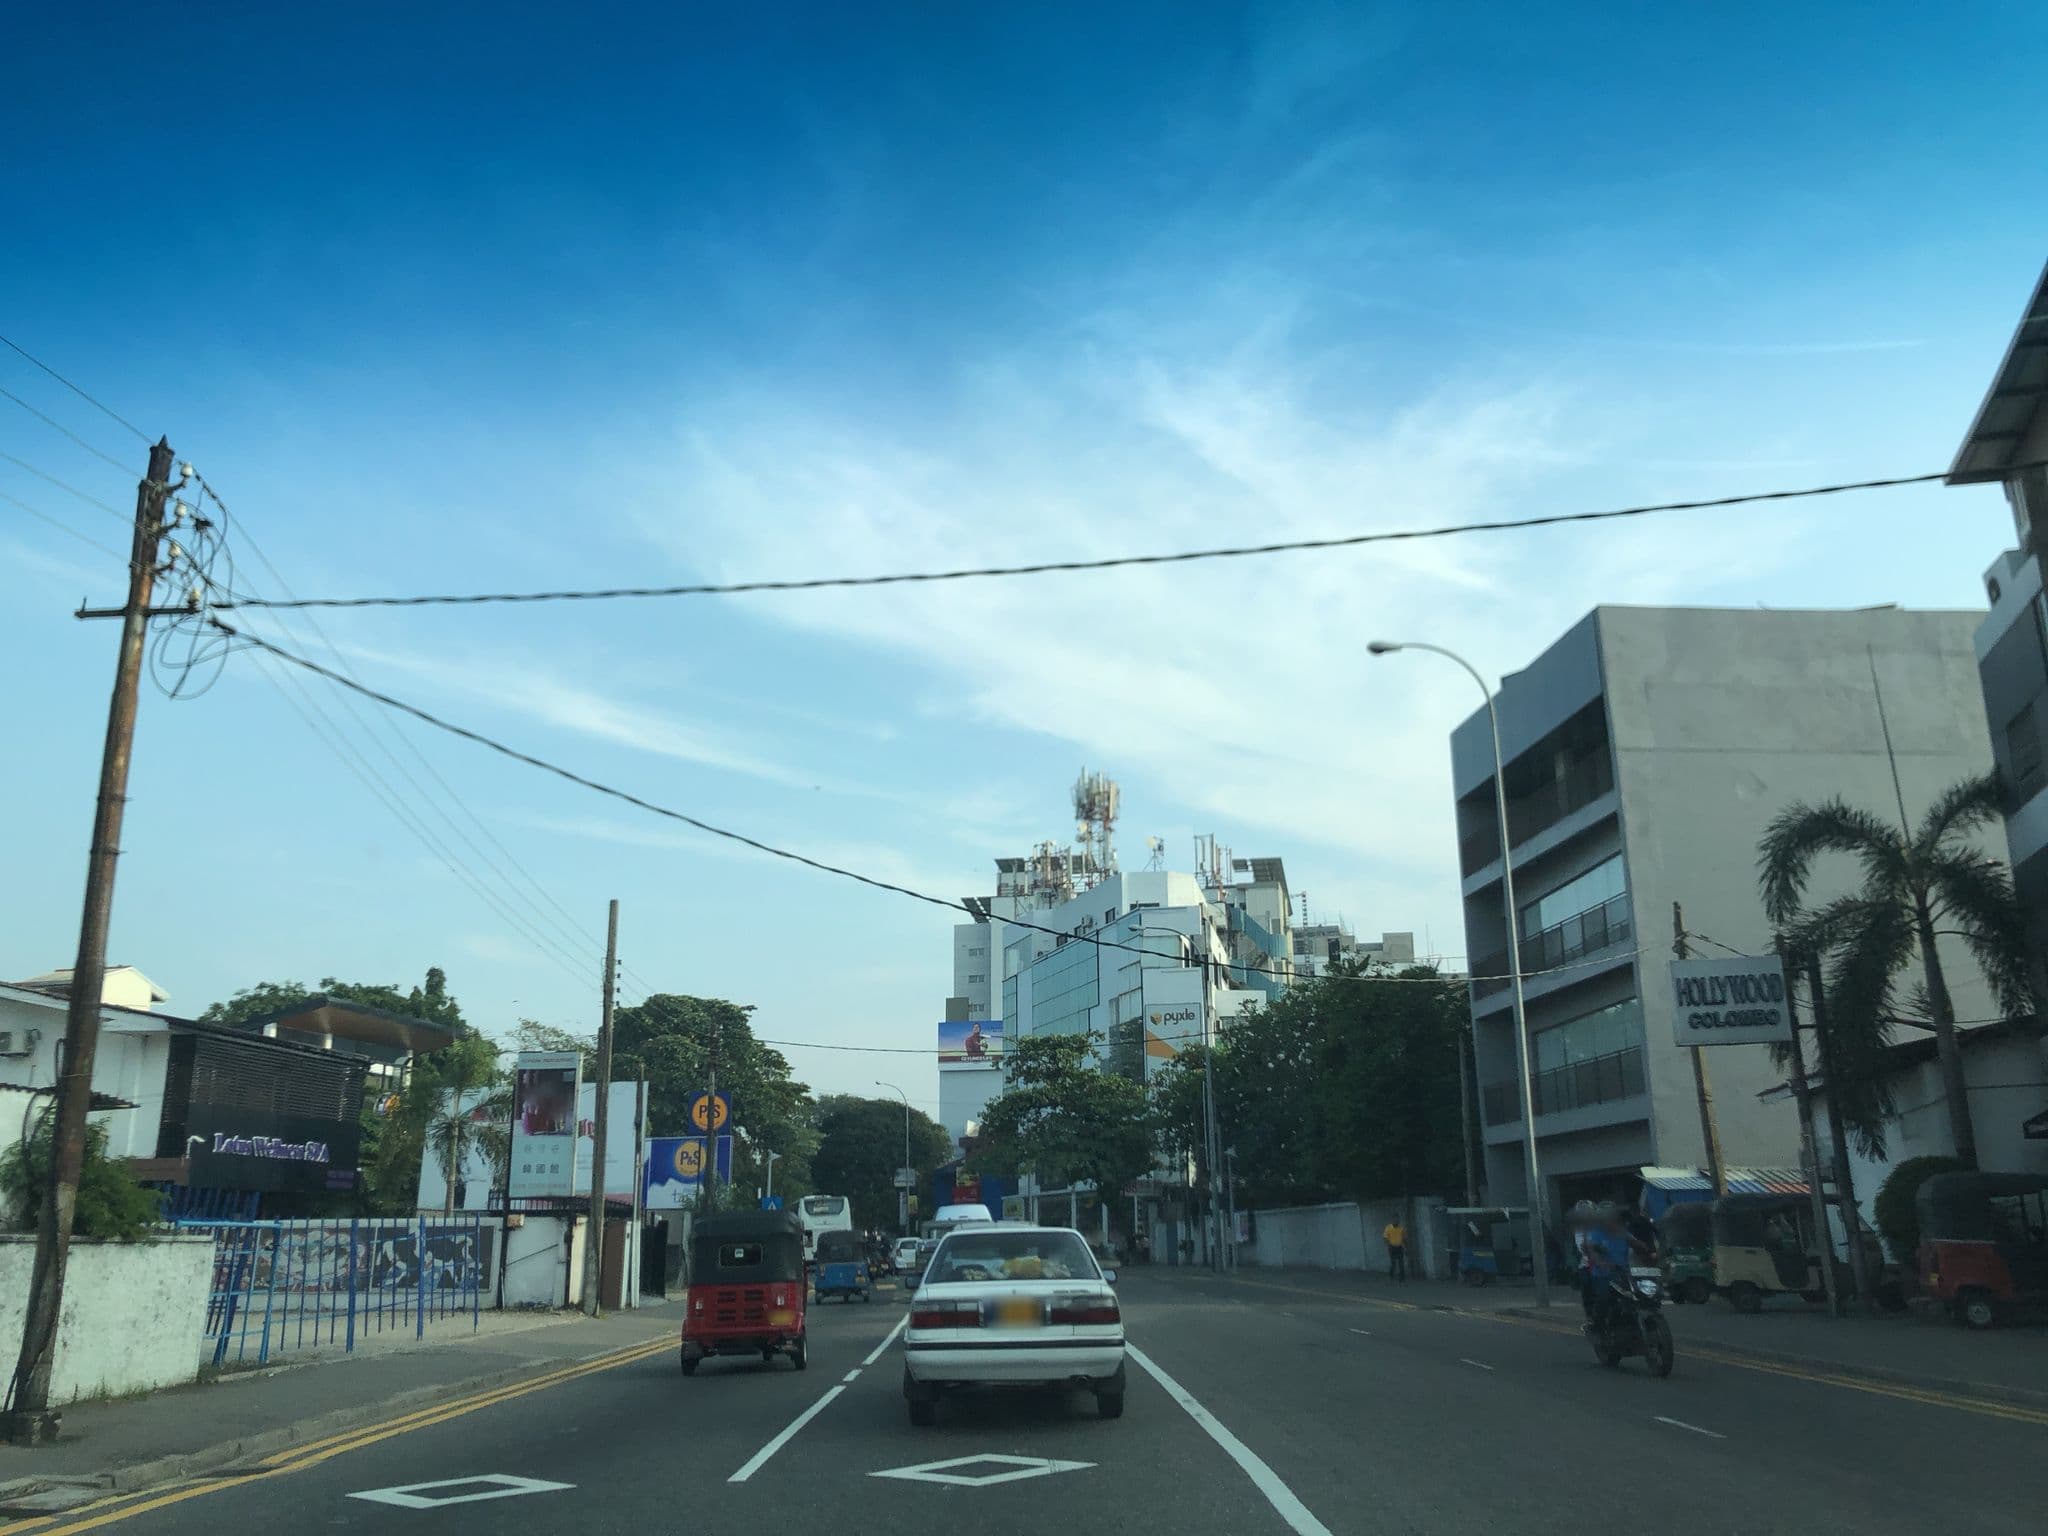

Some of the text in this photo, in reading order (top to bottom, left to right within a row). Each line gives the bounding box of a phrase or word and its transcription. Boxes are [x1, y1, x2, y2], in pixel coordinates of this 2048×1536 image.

[1677, 973, 1784, 1006] HOLLYWOOD
[1164, 1008, 1196, 1026] pyxle
[1688, 1009, 1780, 1029] COLOMBO
